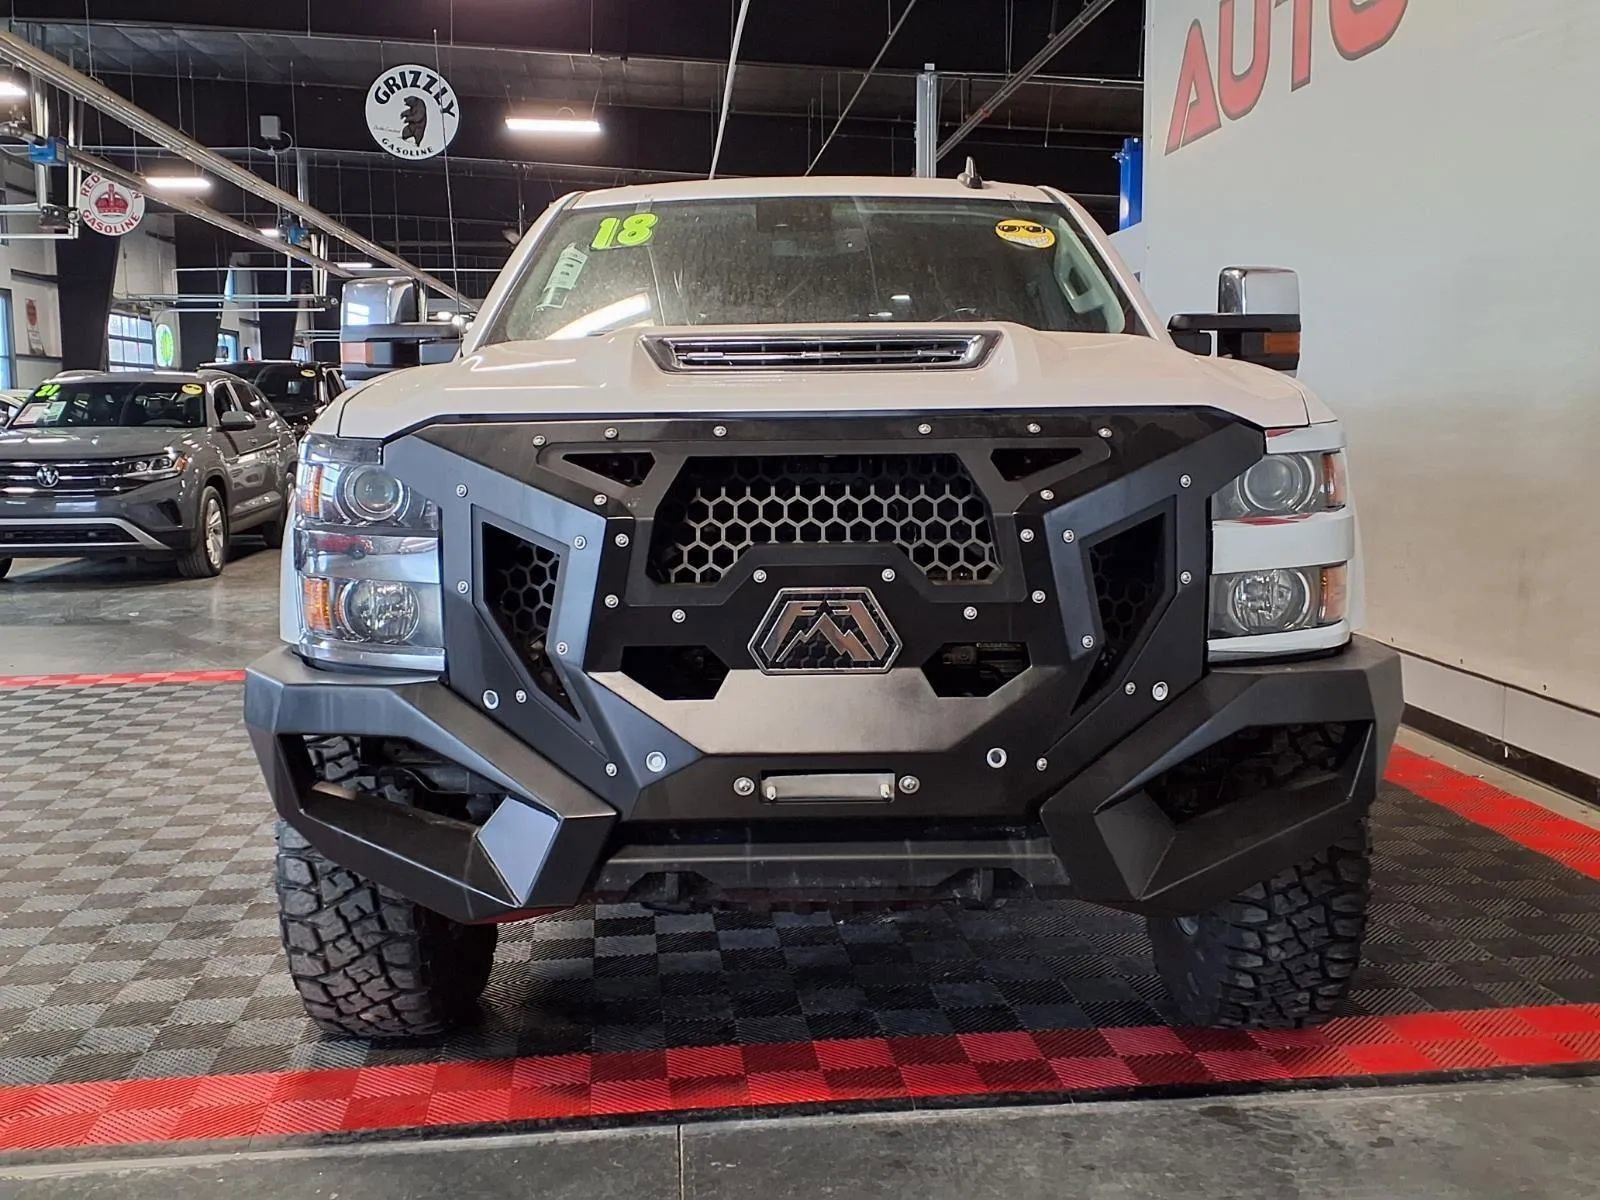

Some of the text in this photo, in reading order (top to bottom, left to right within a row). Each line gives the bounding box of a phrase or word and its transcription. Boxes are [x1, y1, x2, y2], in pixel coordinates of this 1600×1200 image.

[374, 70, 456, 118] GRIZZLY
[382, 138, 434, 156] GASOLINE
[80, 174, 101, 197] RED
[82, 209, 140, 234] GASOLINE
[590, 213, 658, 250] 18
